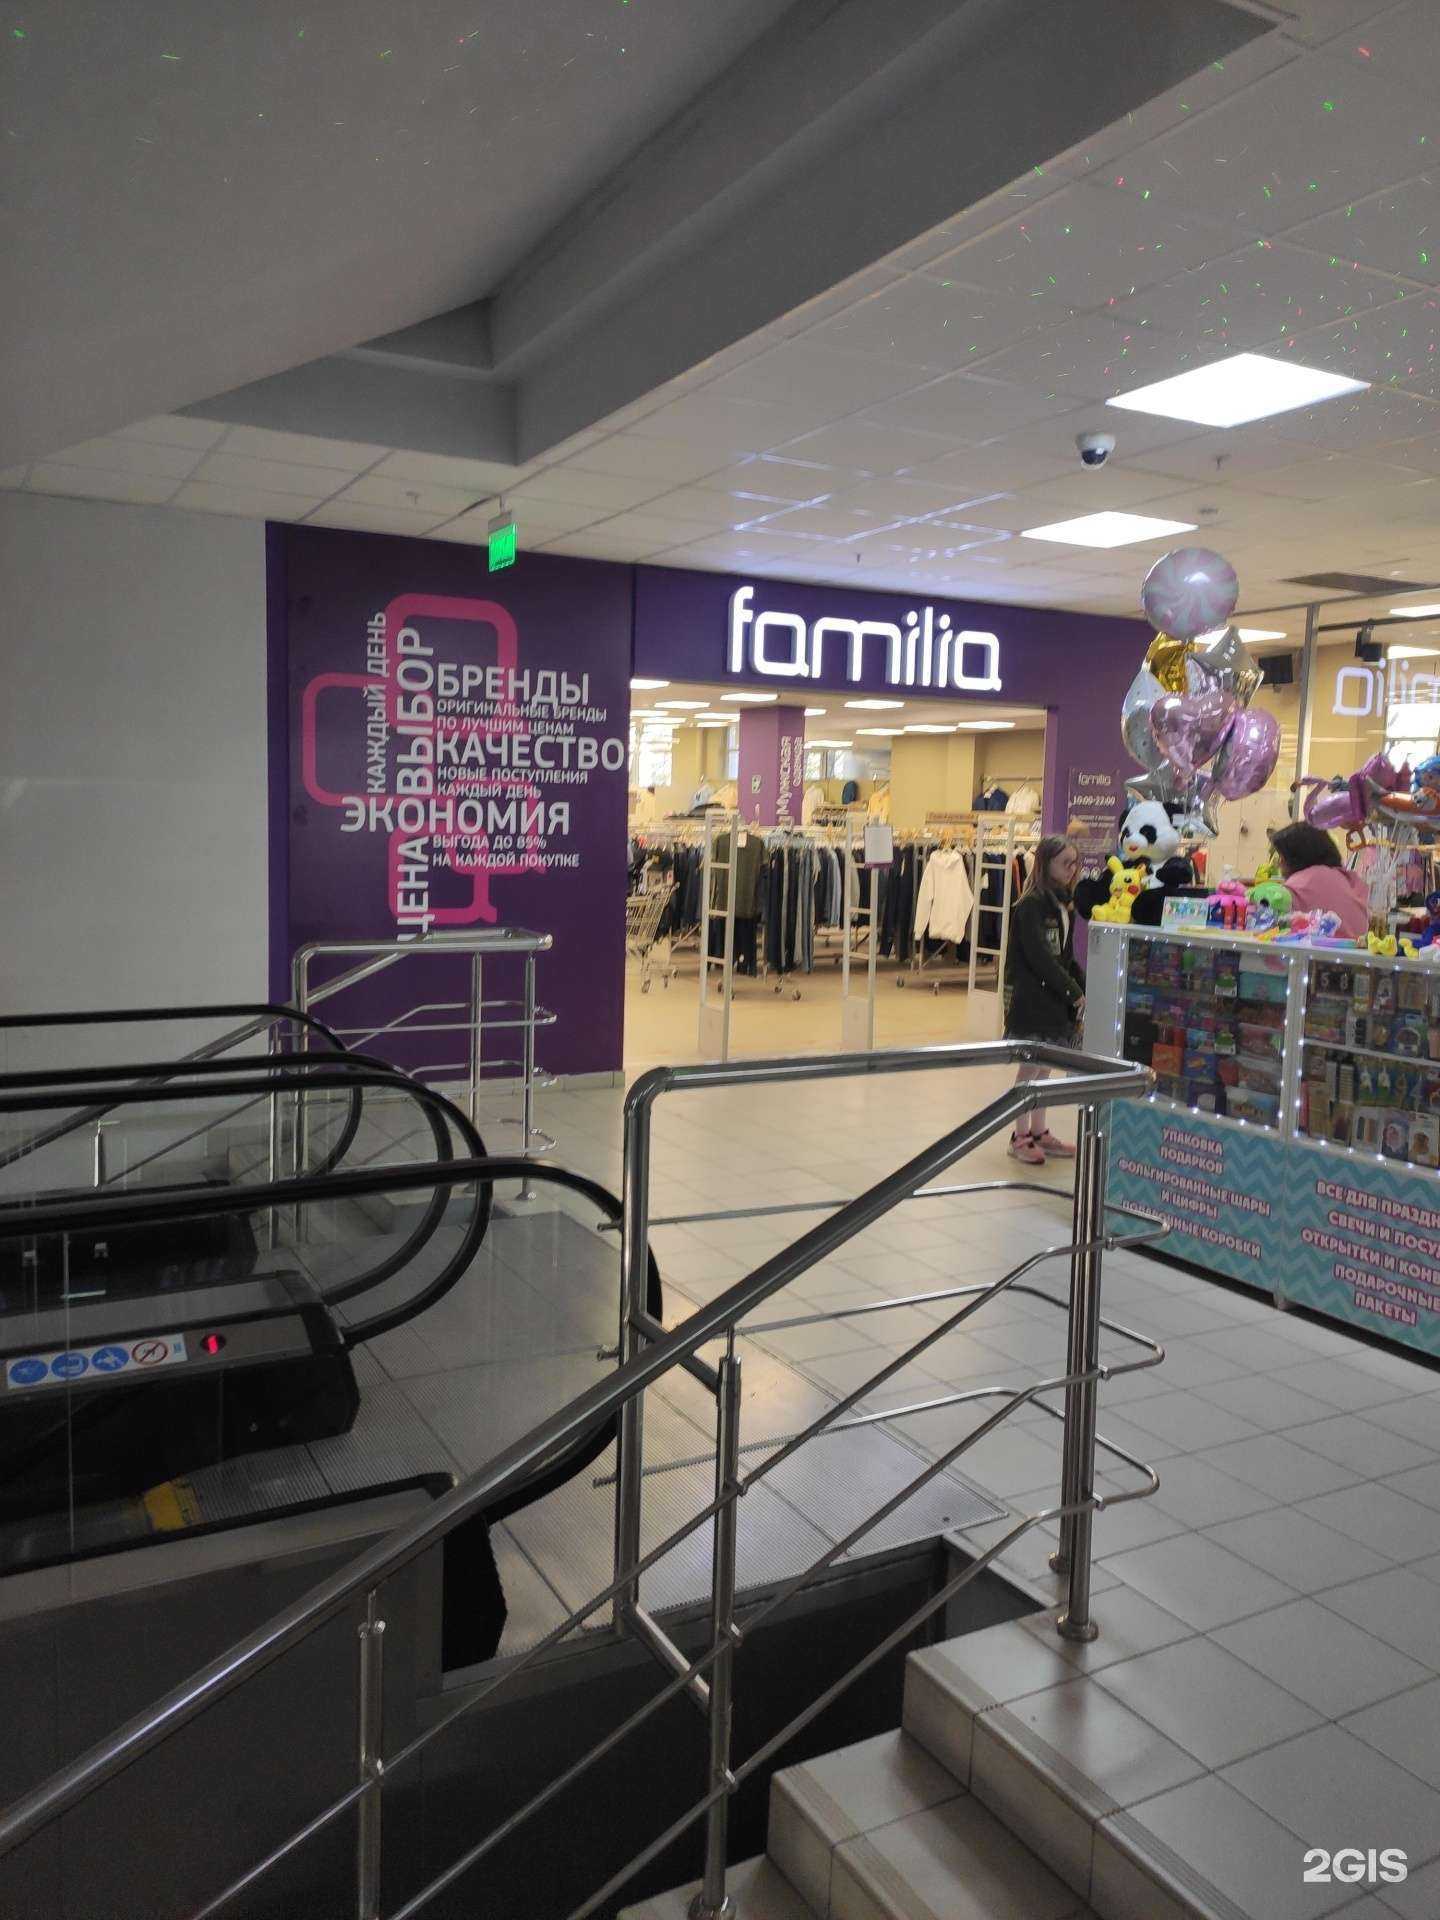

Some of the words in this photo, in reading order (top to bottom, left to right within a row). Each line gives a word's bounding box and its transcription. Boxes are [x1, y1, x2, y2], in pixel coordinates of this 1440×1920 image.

[367, 611, 387, 677] ДЕНЬ
[729, 586, 1002, 692] familia
[437, 662, 589, 713] БРЕНДЫ
[396, 626, 434, 795] ВЫБОР
[436, 698, 550, 719] ОРИГИНАЛЬНЫЕ
[553, 705, 607, 723] БРЕНДЫ
[436, 716, 457, 730] ПО
[461, 716, 524, 733] ЛУЧШИМ
[528, 720, 575, 736] ЦЕНАМ
[362, 684, 387, 794] КАЖДЫЙ
[436, 730, 625, 771] КАЧЕСТВО
[437, 765, 488, 782] НОВЫЕ
[491, 767, 588, 785] ПОСТУПЛЕНИЯ
[437, 781, 502, 799] КАЖДЫЙ
[505, 785, 542, 800] ДЕНЬ
[340, 796, 570, 836] ЭКОНОМИЯ
[432, 834, 490, 850] ВЫГОДА
[493, 836, 513, 851] ДО
[432, 853, 451, 867] НА
[455, 852, 516, 869] КАЖДОЙ
[519, 853, 580, 868] ПОКУПКЕ
[397, 835, 435, 941] ЦЕНА
[1162, 1127, 1224, 1156] УПАКОВКА
[1160, 1146, 1224, 1175] ПОДАРКОВ
[1118, 1158, 1229, 1204] ФОЛЬГИРОВАННЫЕ
[1230, 1188, 1272, 1218] ШАРЫ
[1160, 1189, 1171, 1202] И
[1172, 1193, 1219, 1220] ЦИФРЫ
[1316, 1178, 1345, 1202] ВСЕ
[1346, 1188, 1379, 1211] ДЛЯ
[1201, 1223, 1263, 1260] КОРОБКИ
[1328, 1209, 1377, 1237] СВЕЧИ
[1378, 1225, 1391, 1242] И
[1301, 1227, 1381, 1267] ОТКРЫТКИ
[1383, 1253, 1397, 1271] И
[1354, 1290, 1417, 1327] ПАКЕТЫ
